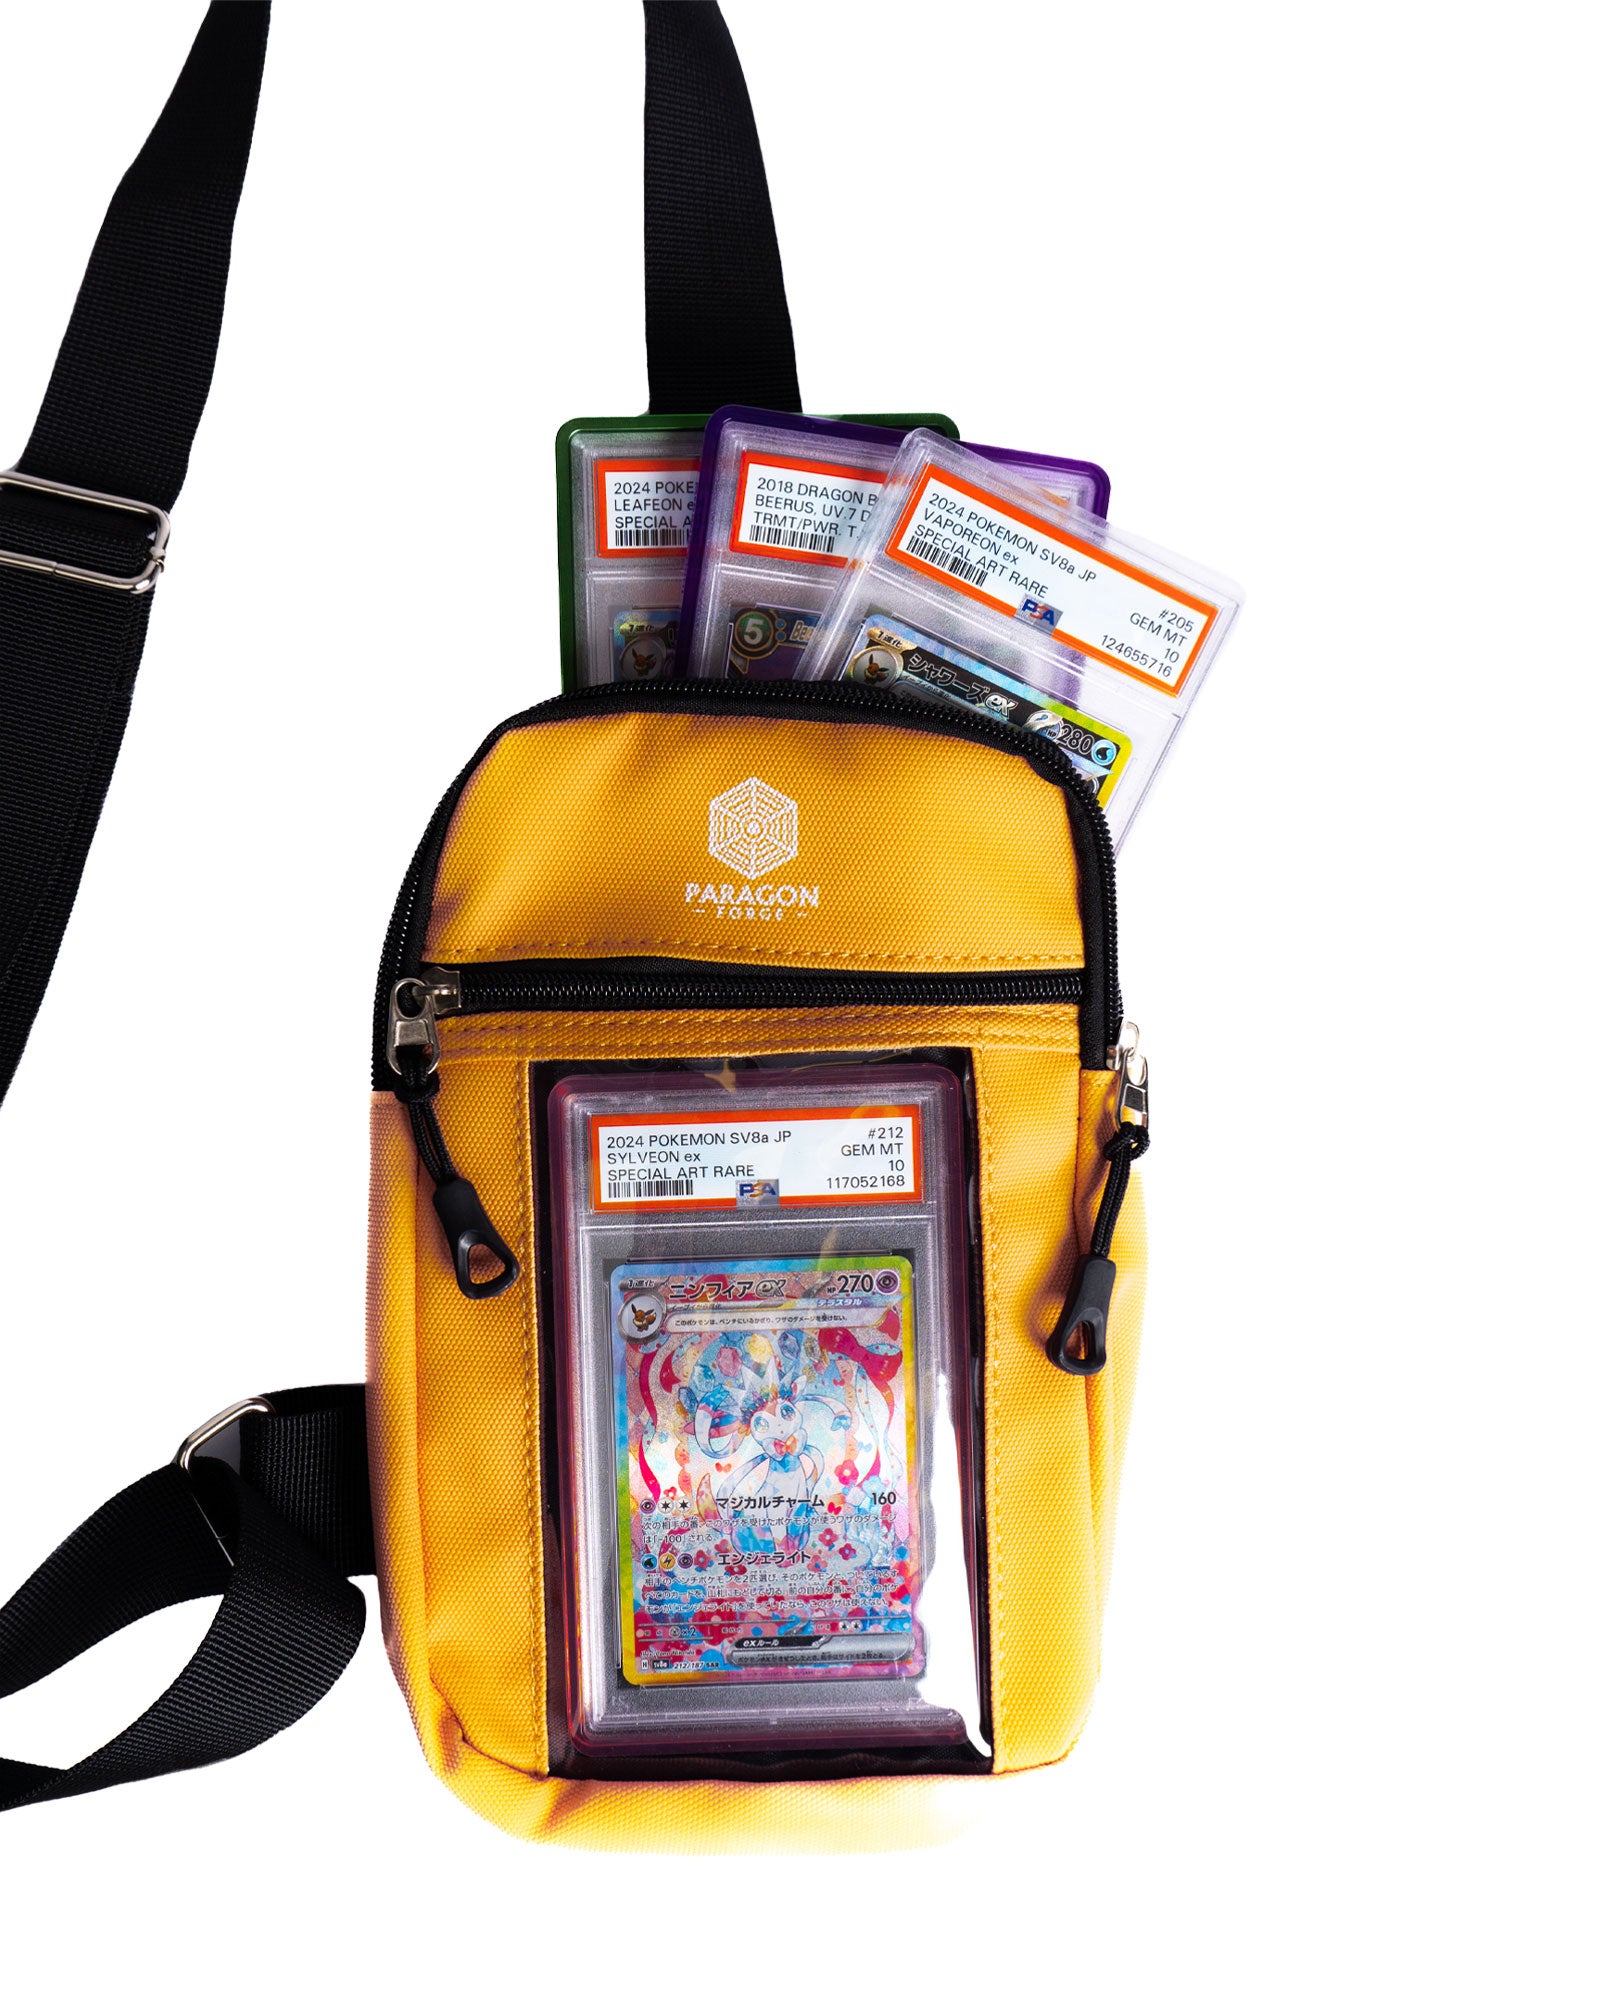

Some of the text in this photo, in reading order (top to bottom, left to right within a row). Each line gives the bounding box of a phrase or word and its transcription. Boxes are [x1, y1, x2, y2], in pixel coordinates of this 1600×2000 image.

[614, 481, 697, 495] 2024 POKE
[757, 477, 793, 493] 2018
[797, 483, 863, 504] DRAGON
[614, 498, 682, 511] LEAFEON
[615, 515, 677, 529] SPECIAL
[924, 508, 1020, 565] VAPOREON ex
[928, 492, 1097, 584] 2024 POKEMON SV8a JP
[914, 524, 1049, 599] SPECIAL ART RARE
[1021, 598, 1055, 625] PSA
[1158, 608, 1195, 633] #205
[743, 618, 764, 645] 5
[1129, 612, 1188, 647] GEM MT
[1101, 634, 1173, 678] 124655716
[1163, 648, 1180, 664] 10
[1057, 724, 1095, 755] 280
[685, 882, 819, 908] PARAGON
[716, 906, 784, 921] FORGE
[607, 1130, 792, 1149] 2024 POKEMON SV8a JP
[867, 1127, 904, 1140] #212
[607, 1151, 701, 1165] SYLVEON ex
[841, 1143, 904, 1157] GEM MT
[608, 1165, 755, 1182] SPECIAL ART RARE
[889, 1159, 905, 1172] 10
[739, 1181, 776, 1198] PSA
[826, 1175, 906, 1189] 117052168
[837, 1274, 874, 1293] 270
[715, 1494, 825, 1510] マジカルチャーム
[872, 1491, 897, 1505] 160
[717, 1551, 811, 1566] エンジェライト
